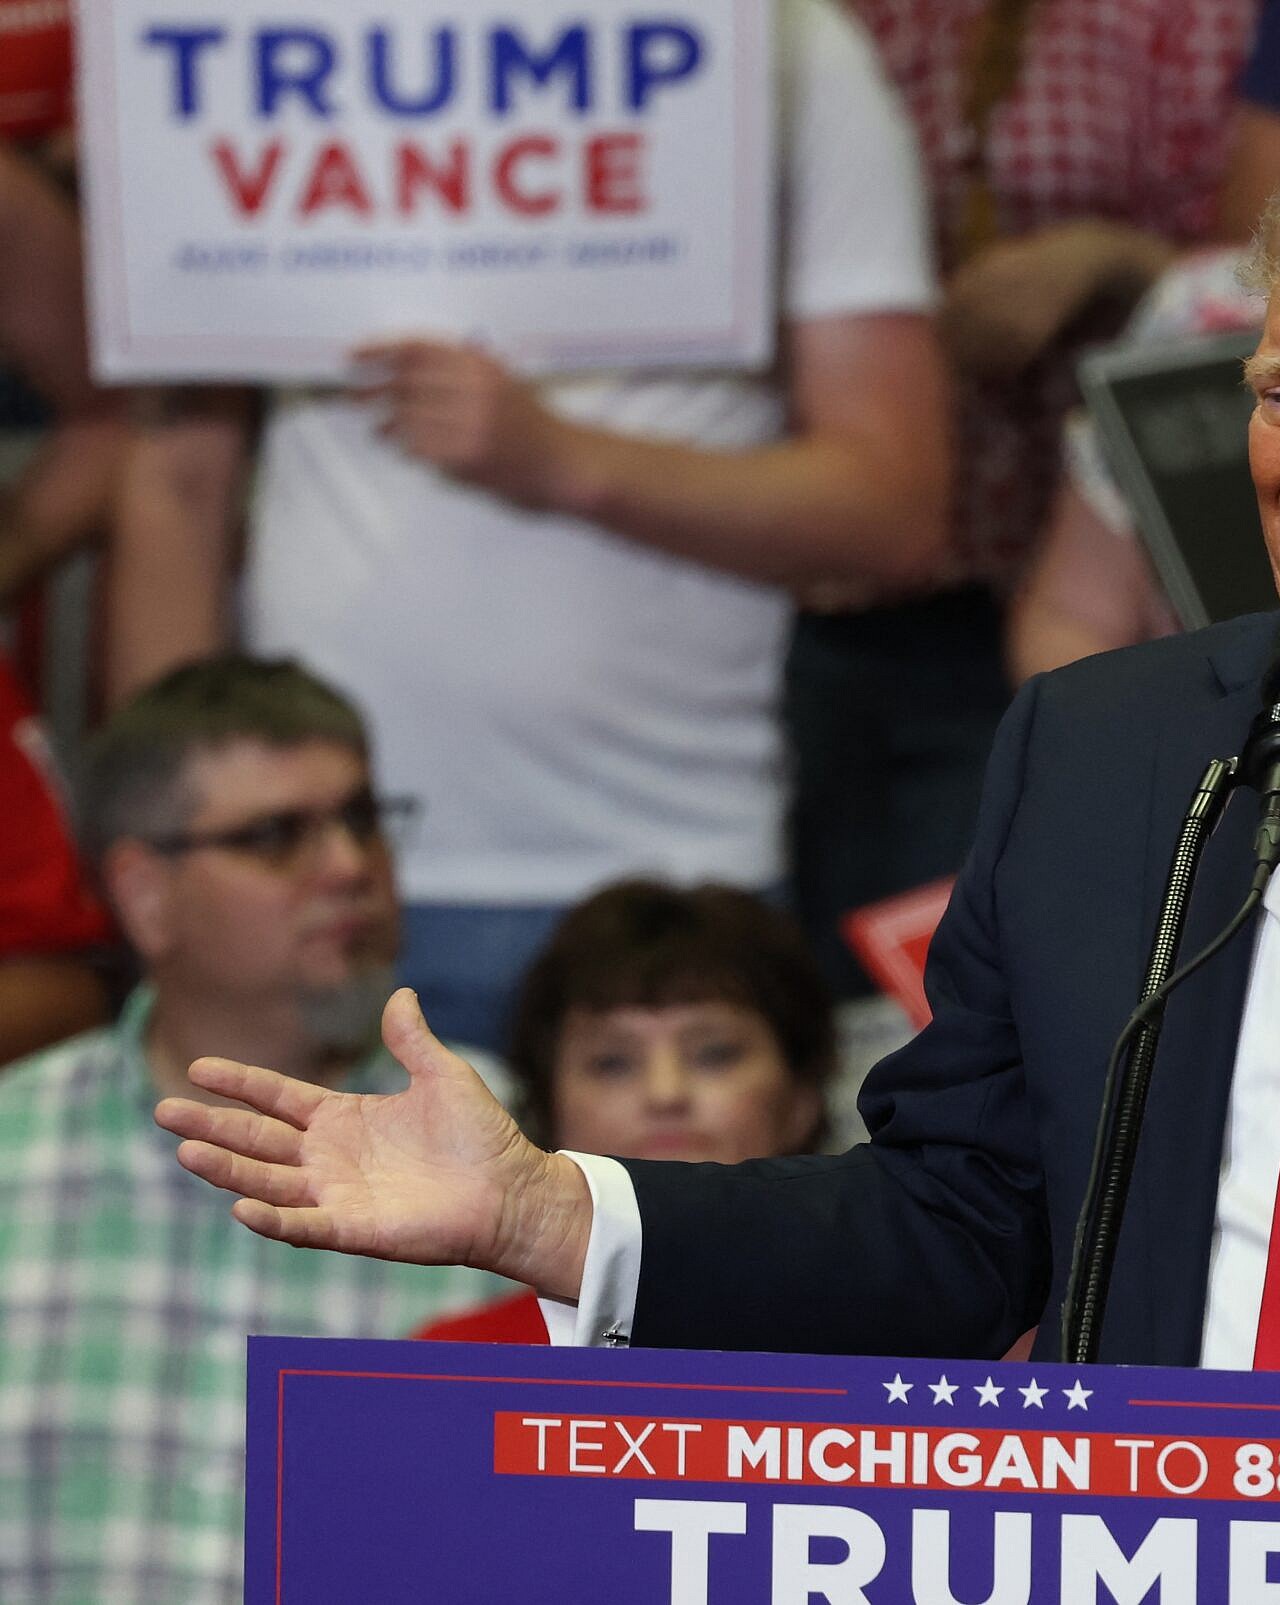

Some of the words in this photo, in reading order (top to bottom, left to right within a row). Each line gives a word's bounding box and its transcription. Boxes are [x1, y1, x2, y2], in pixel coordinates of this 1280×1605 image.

[141, 22, 706, 122] TRUMP
[210, 134, 650, 218] VANCE
[521, 1417, 703, 1477] TEXT
[726, 1425, 1092, 1491] MICHIGAN
[1113, 1438, 1210, 1495] TO
